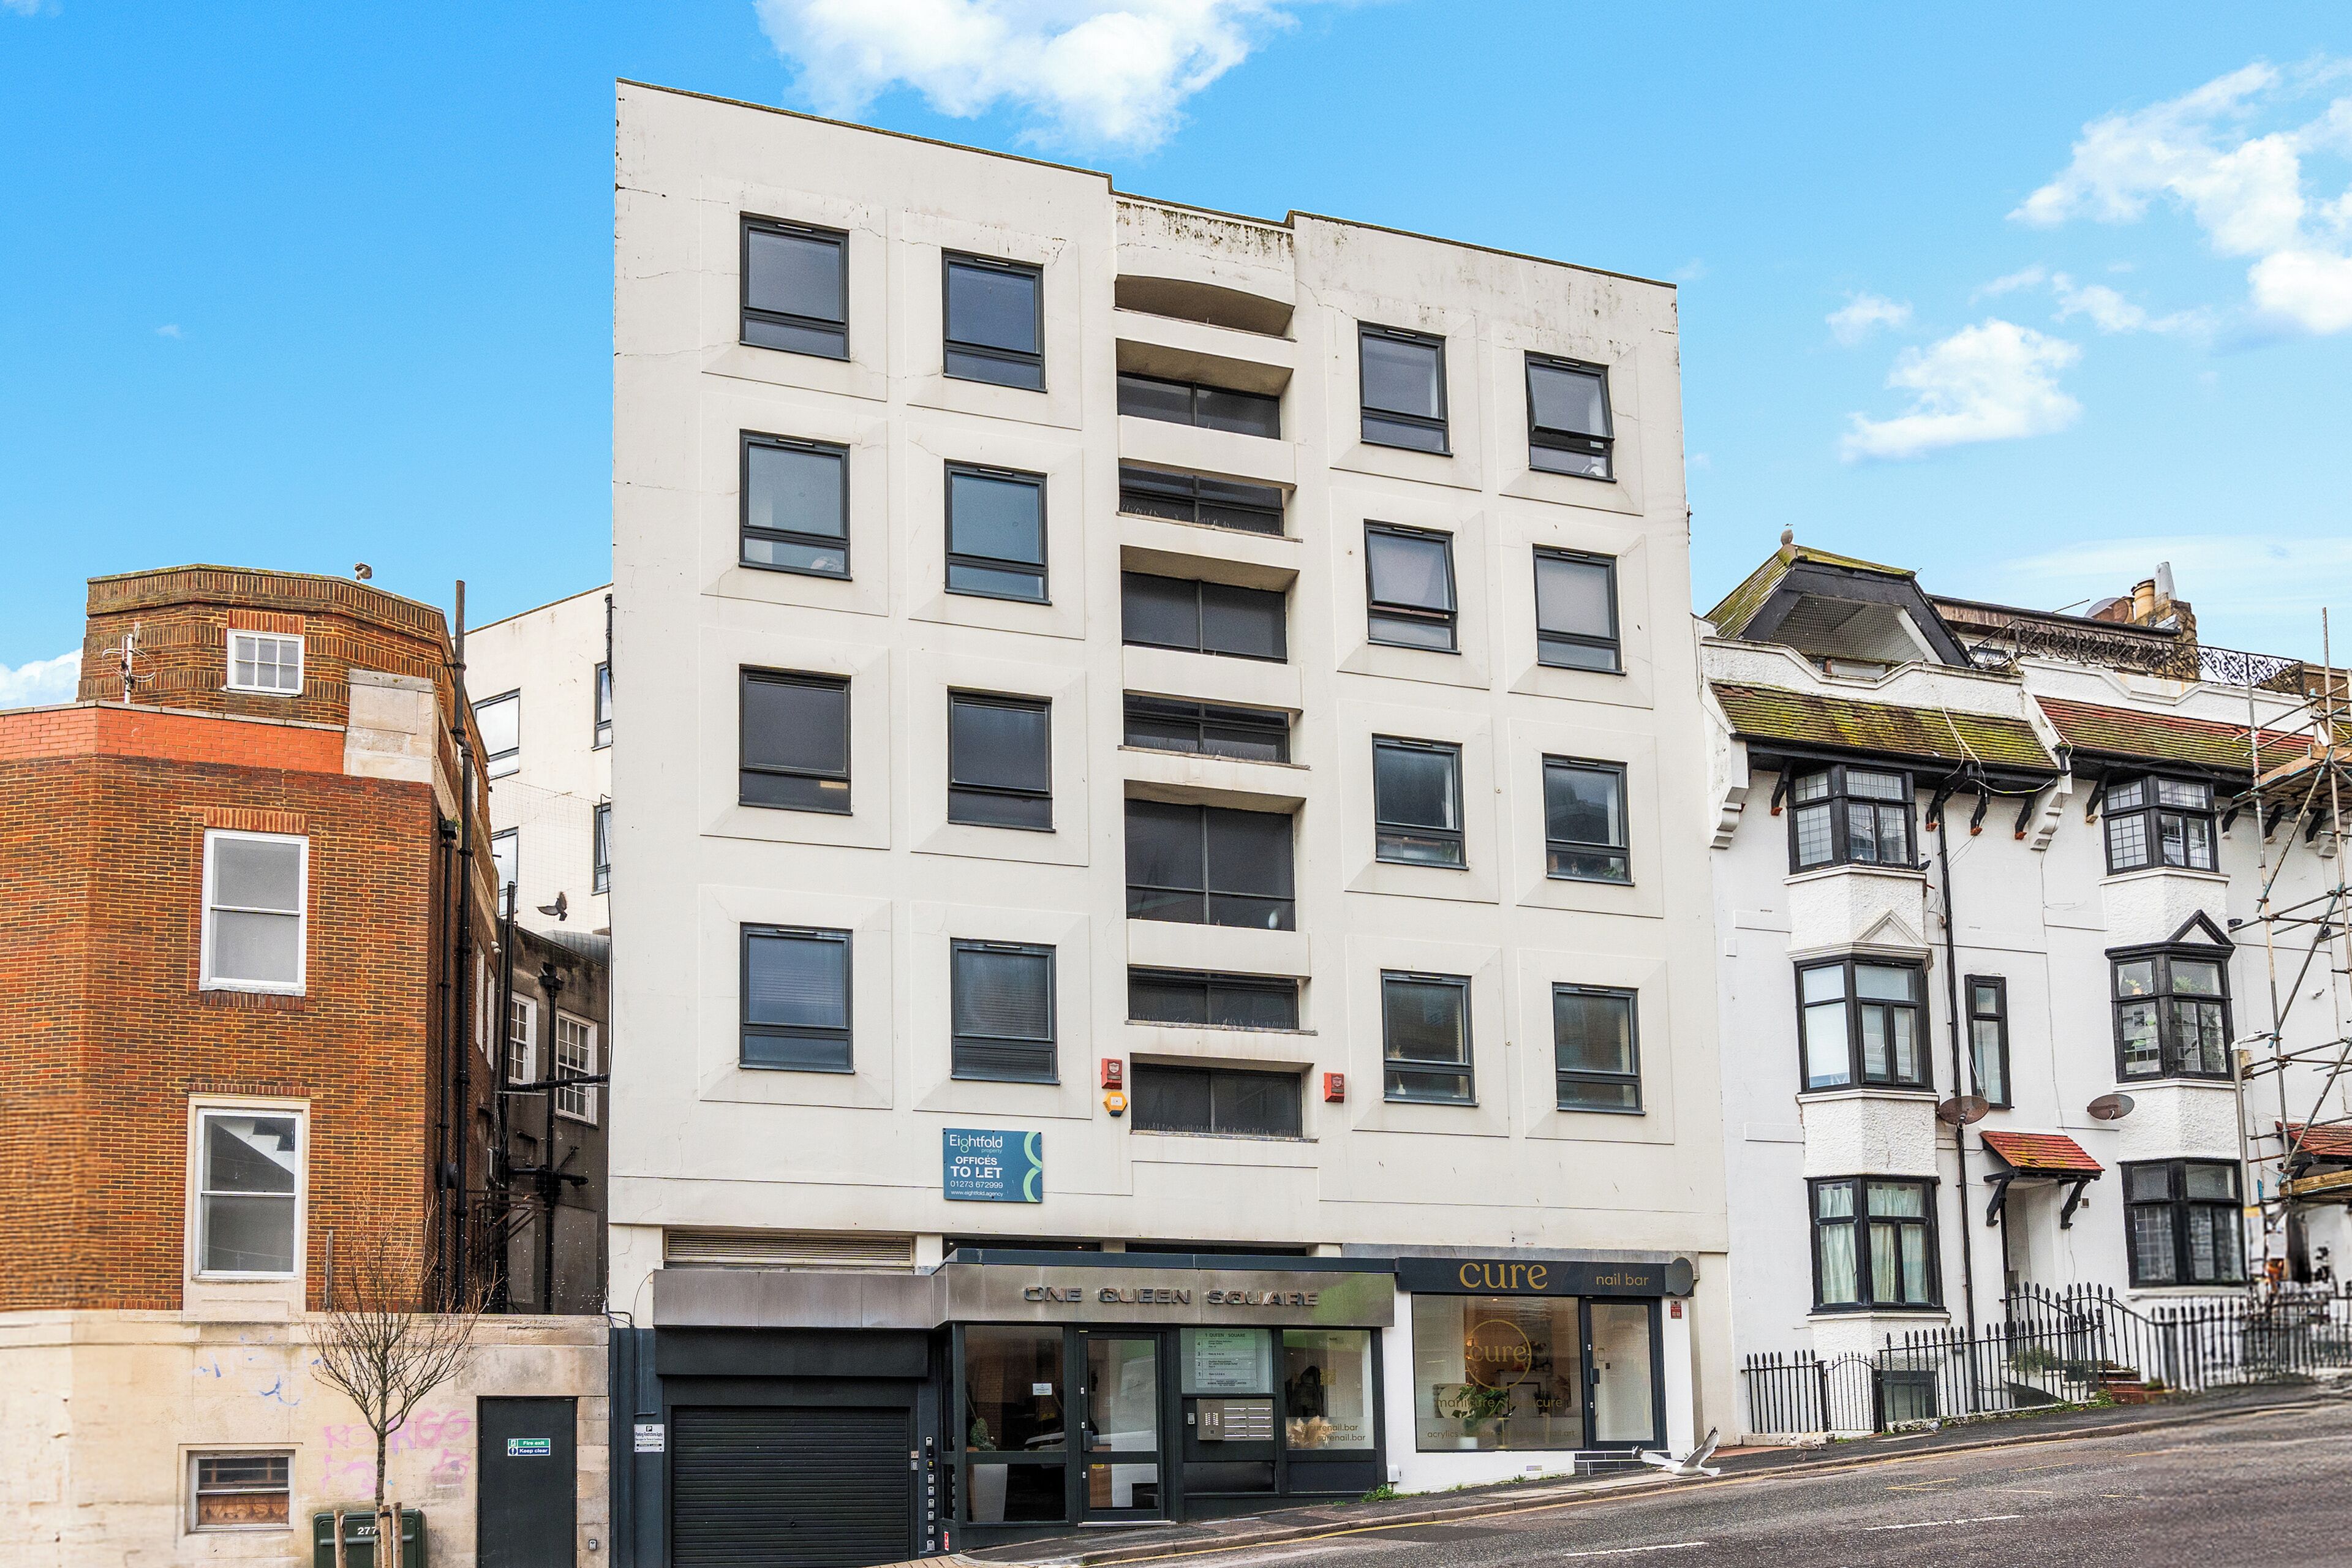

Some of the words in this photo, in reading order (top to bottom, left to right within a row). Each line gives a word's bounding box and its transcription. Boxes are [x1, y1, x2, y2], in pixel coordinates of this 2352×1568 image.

[955, 1156, 997, 1165] OFFICES
[950, 1166, 971, 1177] TO
[975, 1166, 1003, 1178] LET
[1459, 1262, 1548, 1289] cure
[1596, 1273, 1621, 1285] nail
[1625, 1273, 1649, 1286] bar
[1024, 1286, 1082, 1302] ONE
[1098, 1287, 1191, 1304] QUEEN
[1207, 1289, 1319, 1306] SQUARE
[1469, 1344, 1528, 1362] cure
[1436, 1397, 1495, 1408] manicure
[1427, 1430, 1458, 1439] acrylics
